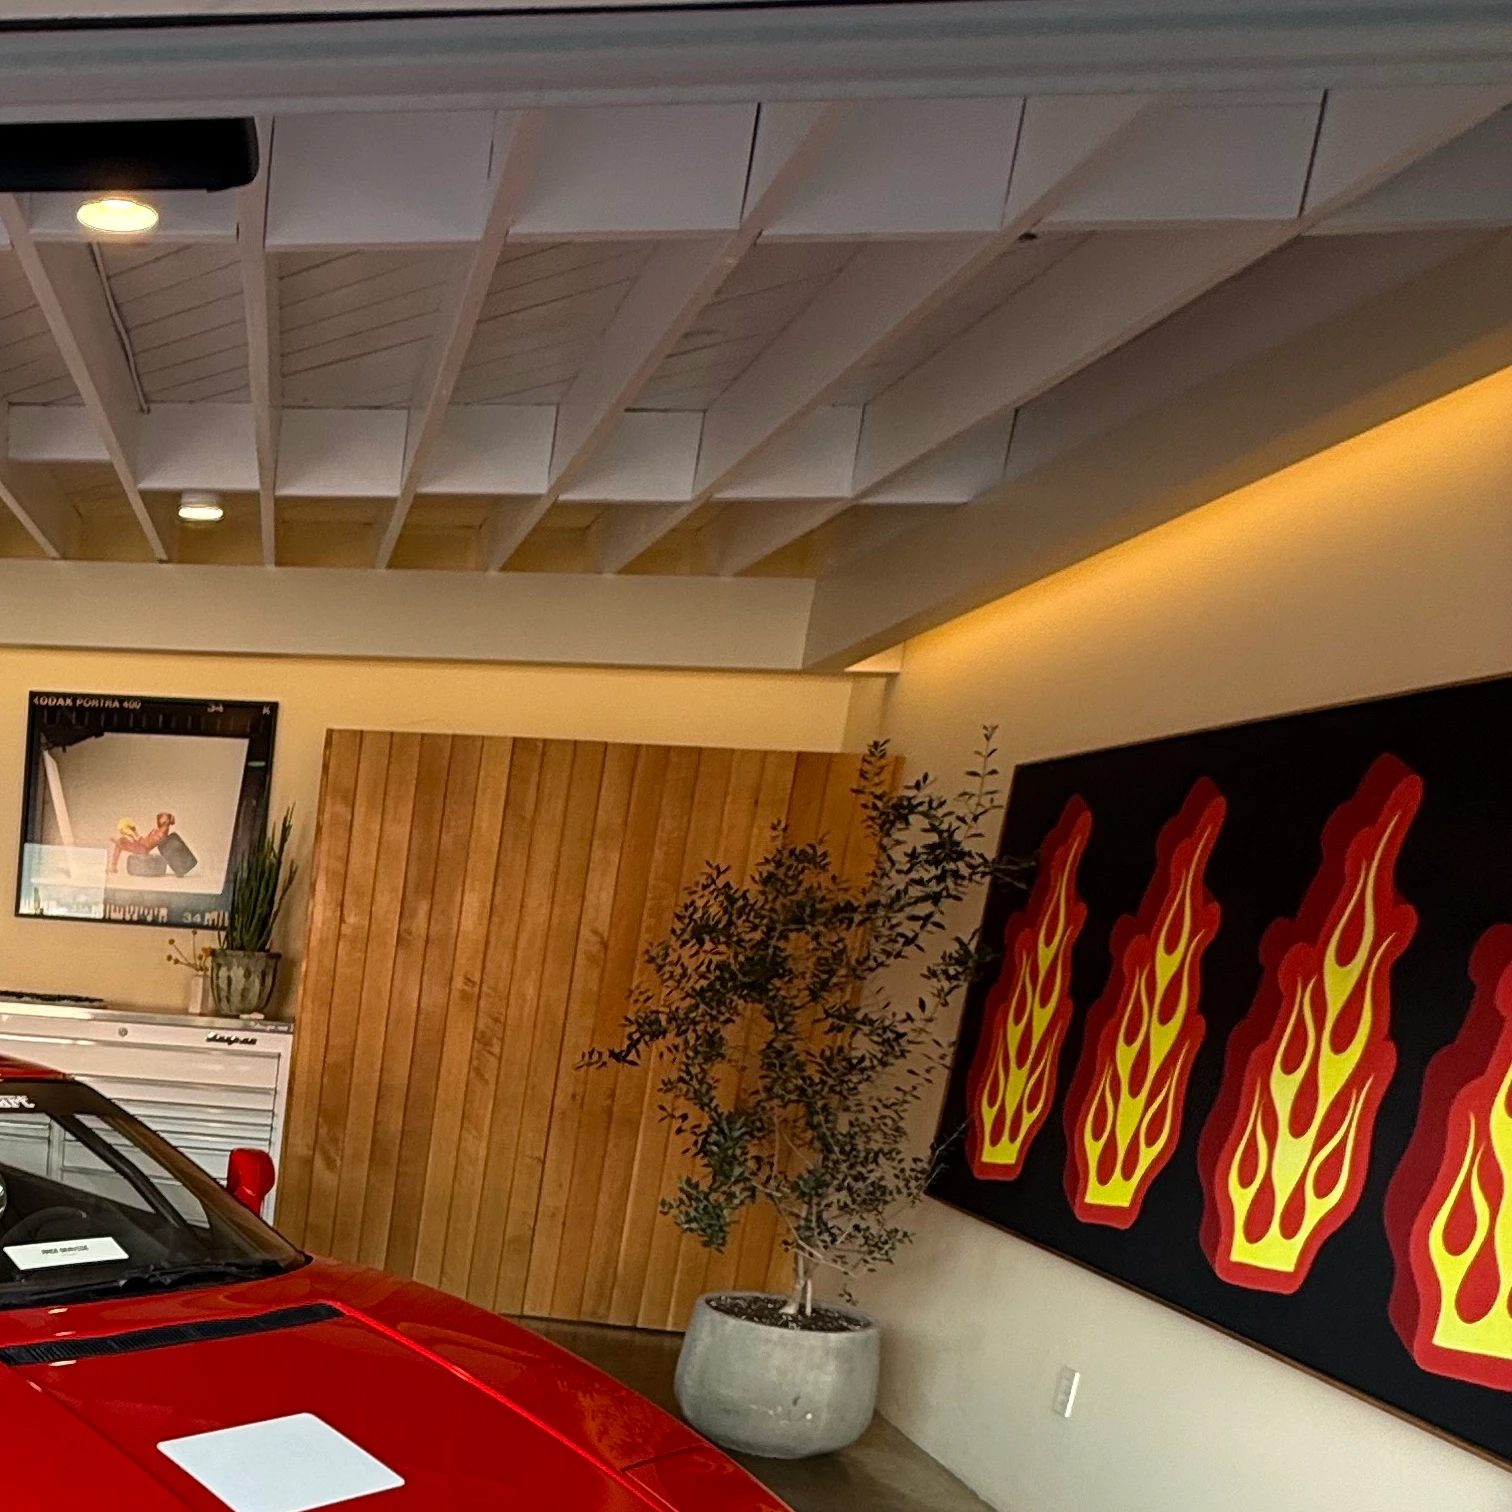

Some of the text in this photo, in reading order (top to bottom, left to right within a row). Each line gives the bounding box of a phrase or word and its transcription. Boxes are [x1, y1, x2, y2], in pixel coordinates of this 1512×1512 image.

[76, 697, 120, 709] PORTRA
[122, 699, 142, 710] 400
[183, 911, 202, 924] 34
